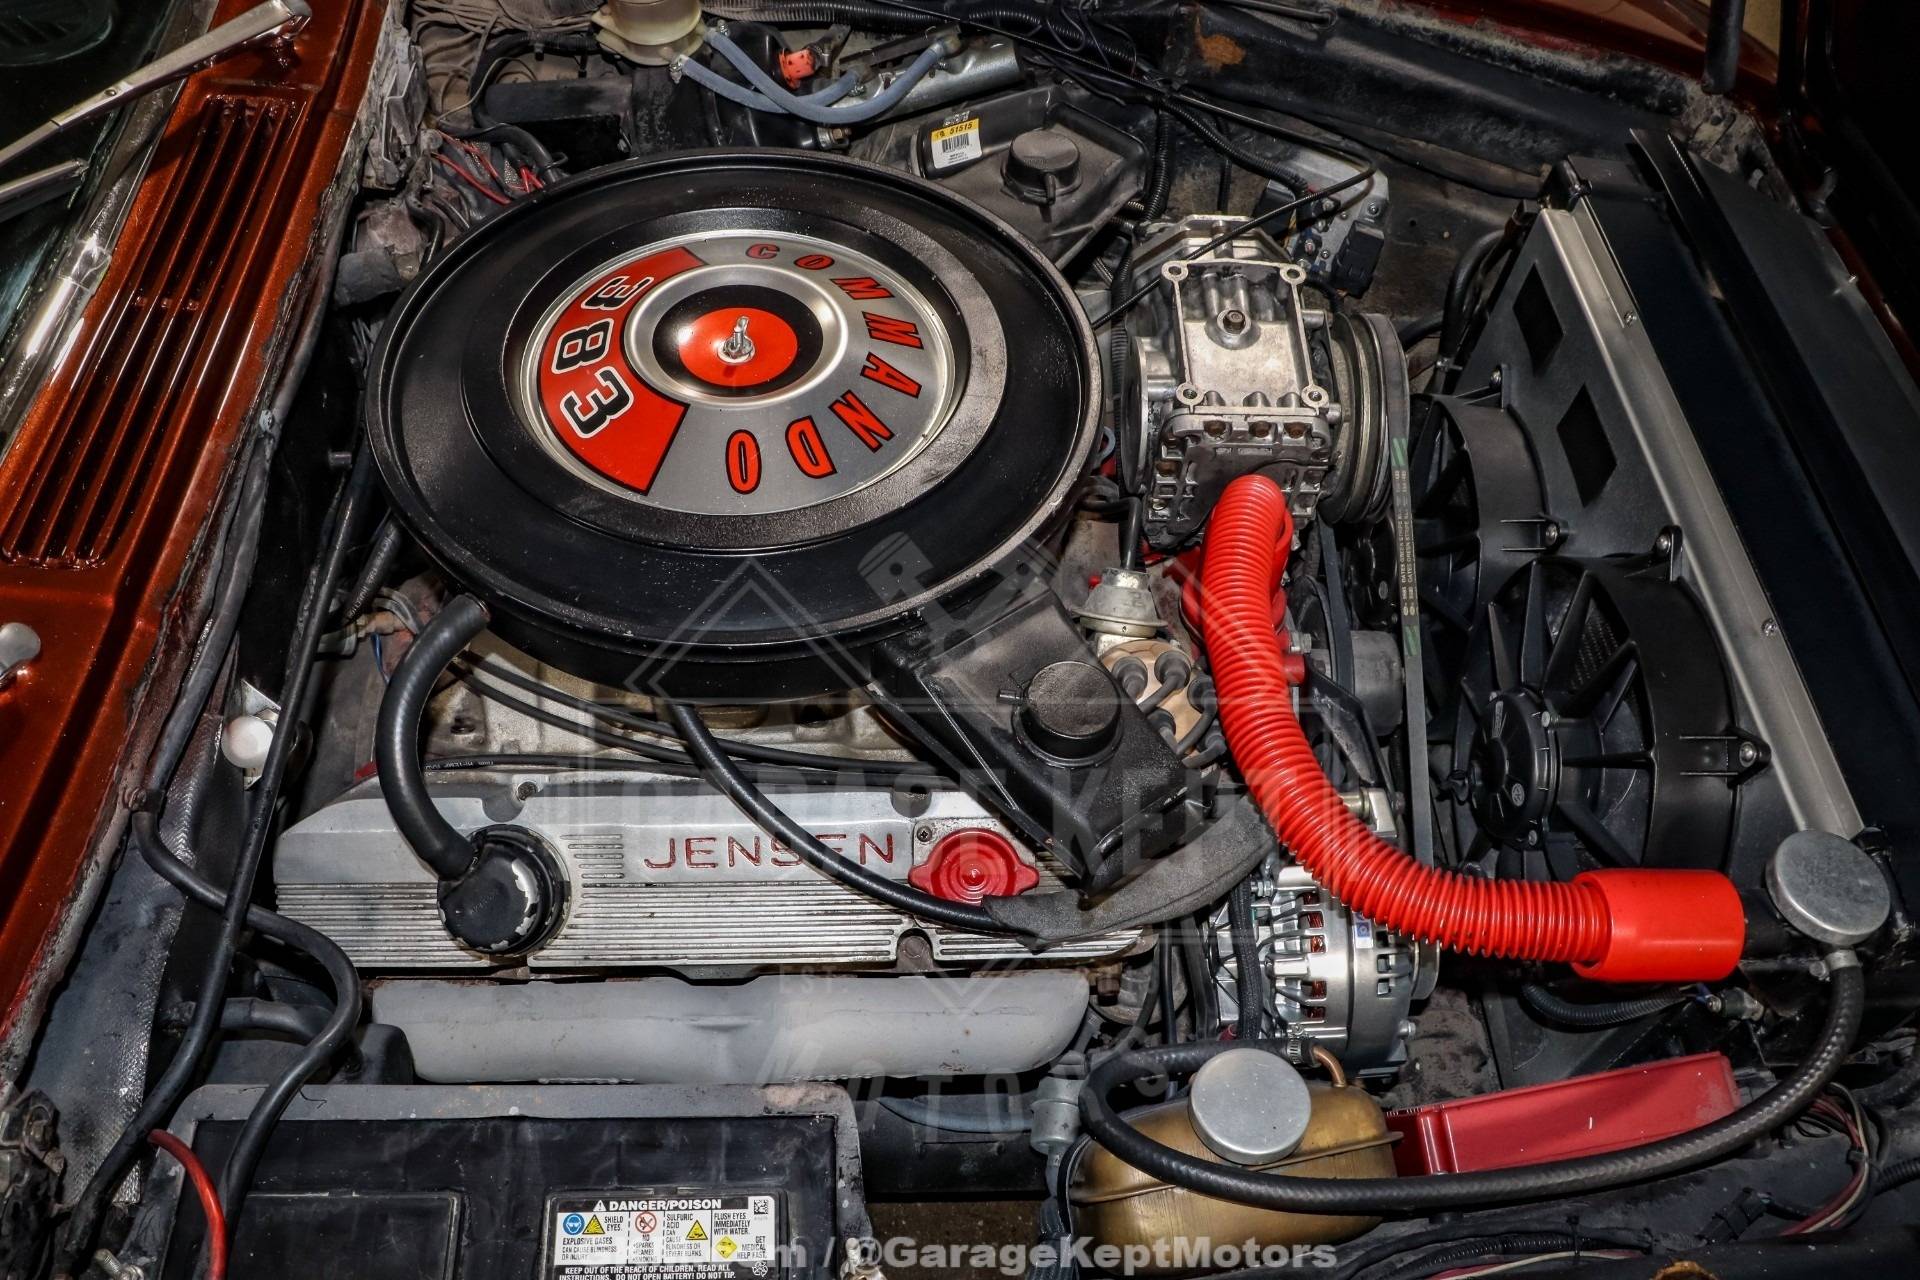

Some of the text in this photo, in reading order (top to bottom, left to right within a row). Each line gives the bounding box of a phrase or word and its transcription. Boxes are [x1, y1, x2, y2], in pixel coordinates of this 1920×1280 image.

[552, 275, 654, 439] 383
[725, 243, 924, 495] COMMANDO
[609, 1199, 722, 1211] DANGER/POISON
[714, 1220, 751, 1228] IMMEDIATELY
[594, 1237, 613, 1245] GASES
[755, 1235, 766, 1243] GET
[742, 1243, 766, 1251] MEDICAL
[736, 1251, 751, 1259] HELP
[610, 1266, 624, 1274] THE
[648, 1265, 659, 1273] OF
[659, 1265, 696, 1273] CHILDREN.
[697, 1264, 717, 1272] READ
[723, 1271, 736, 1279] TIP.
